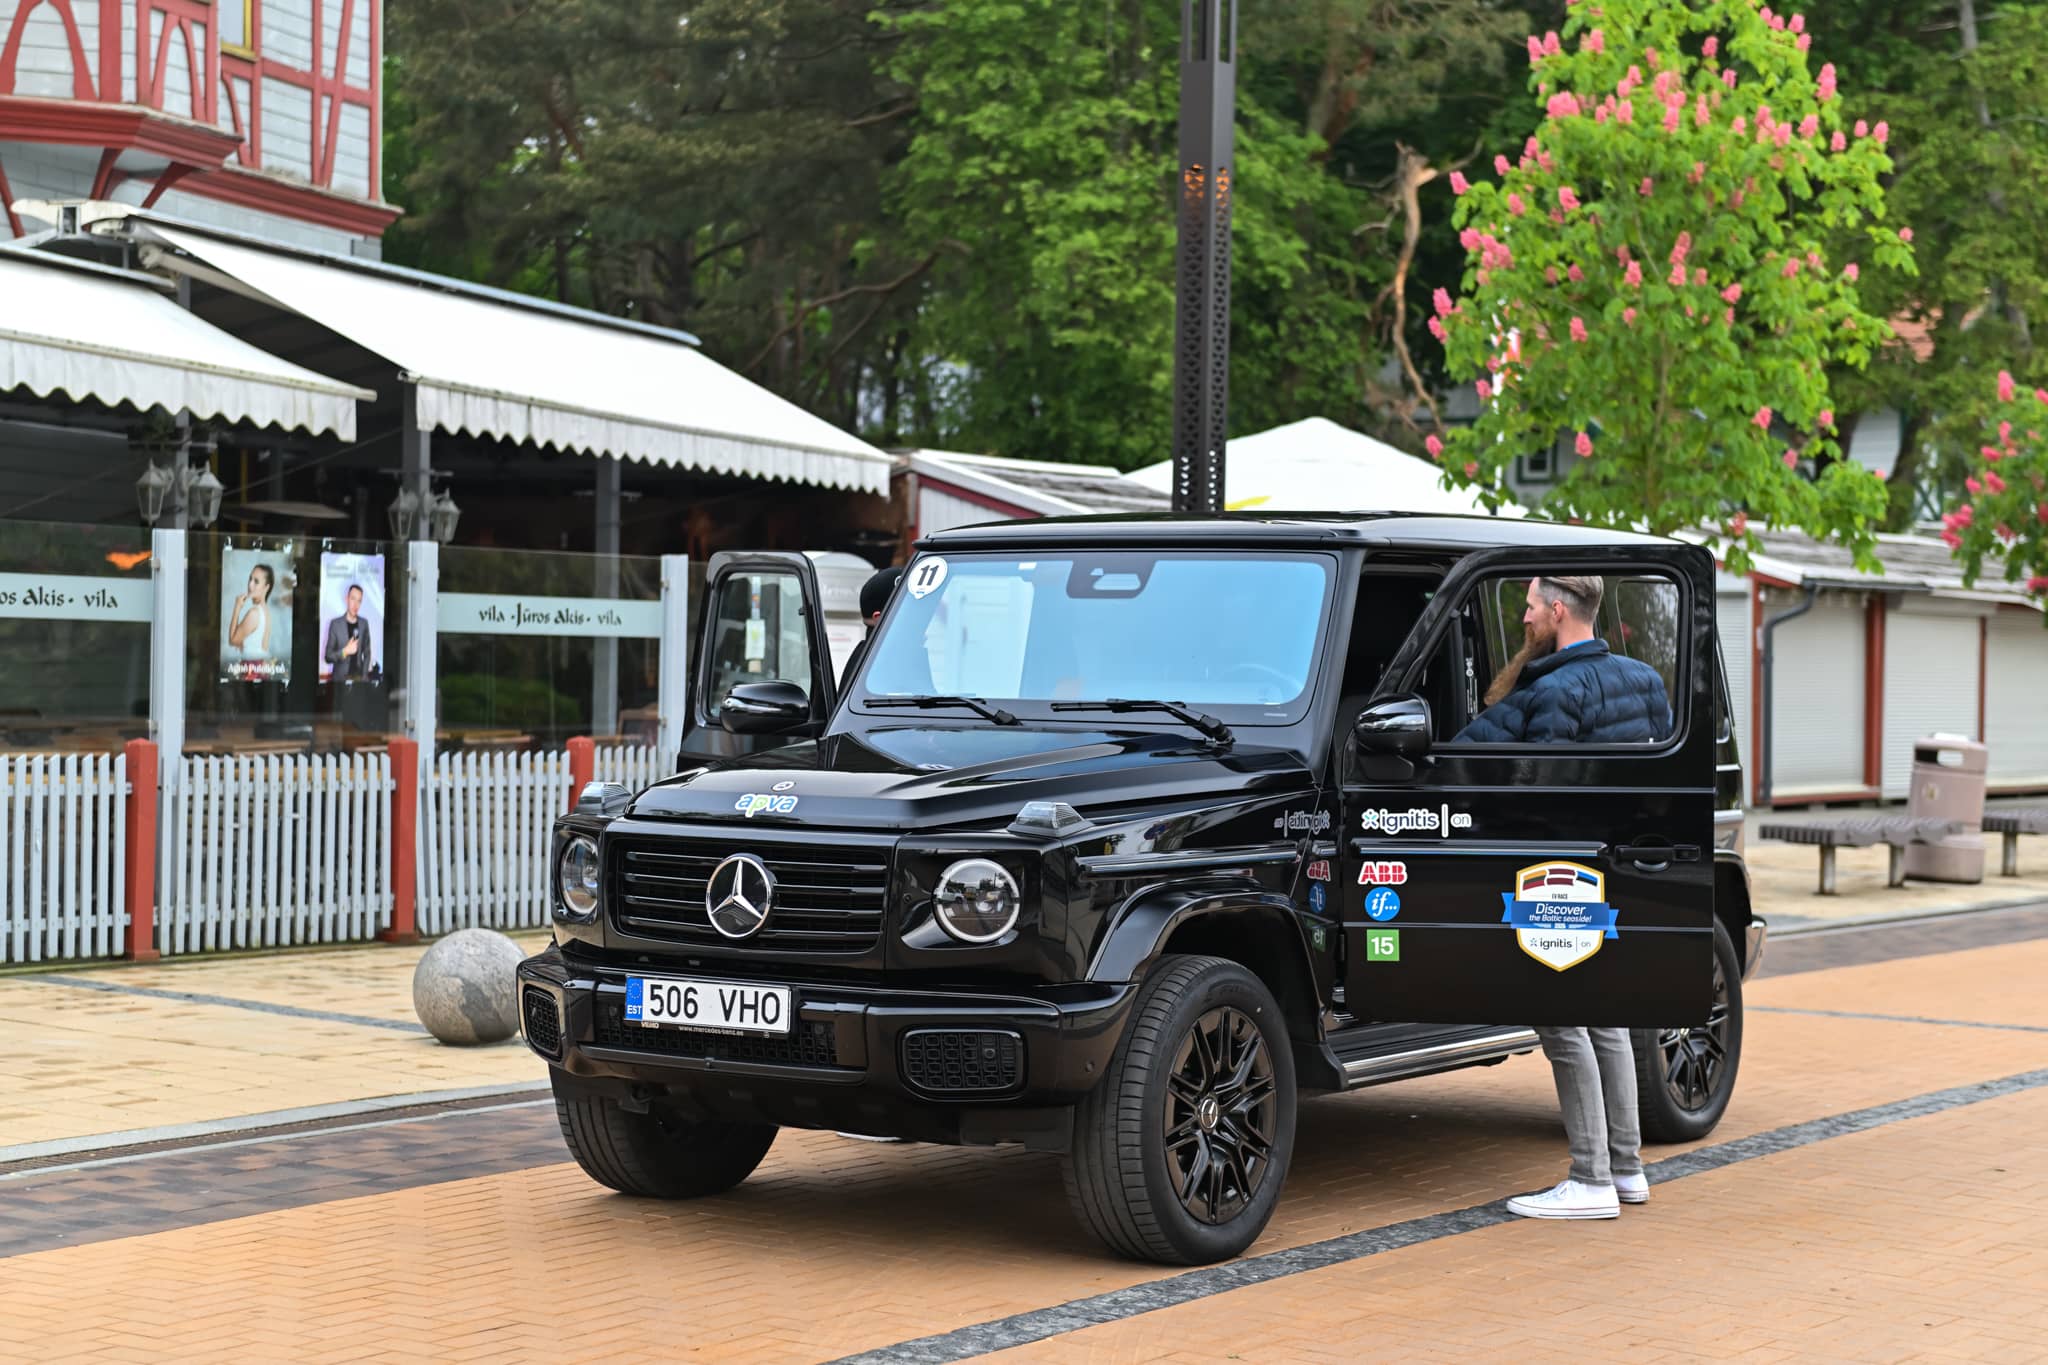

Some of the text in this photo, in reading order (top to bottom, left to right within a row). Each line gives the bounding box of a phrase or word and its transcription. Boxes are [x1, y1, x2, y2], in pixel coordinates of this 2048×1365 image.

[916, 564, 940, 586] 11
[83, 587, 119, 609] vila
[478, 604, 505, 623] vila
[597, 608, 623, 626] vila
[736, 794, 797, 817] apva
[1381, 809, 1471, 832] ignitis on
[1361, 864, 1405, 883] ABB
[1529, 914, 1592, 923] the Baltic seaside!
[1535, 902, 1587, 915] Discover
[1371, 936, 1394, 955] 15
[1540, 937, 1573, 950] ignitis
[627, 983, 781, 1025] EST 506 VHO
